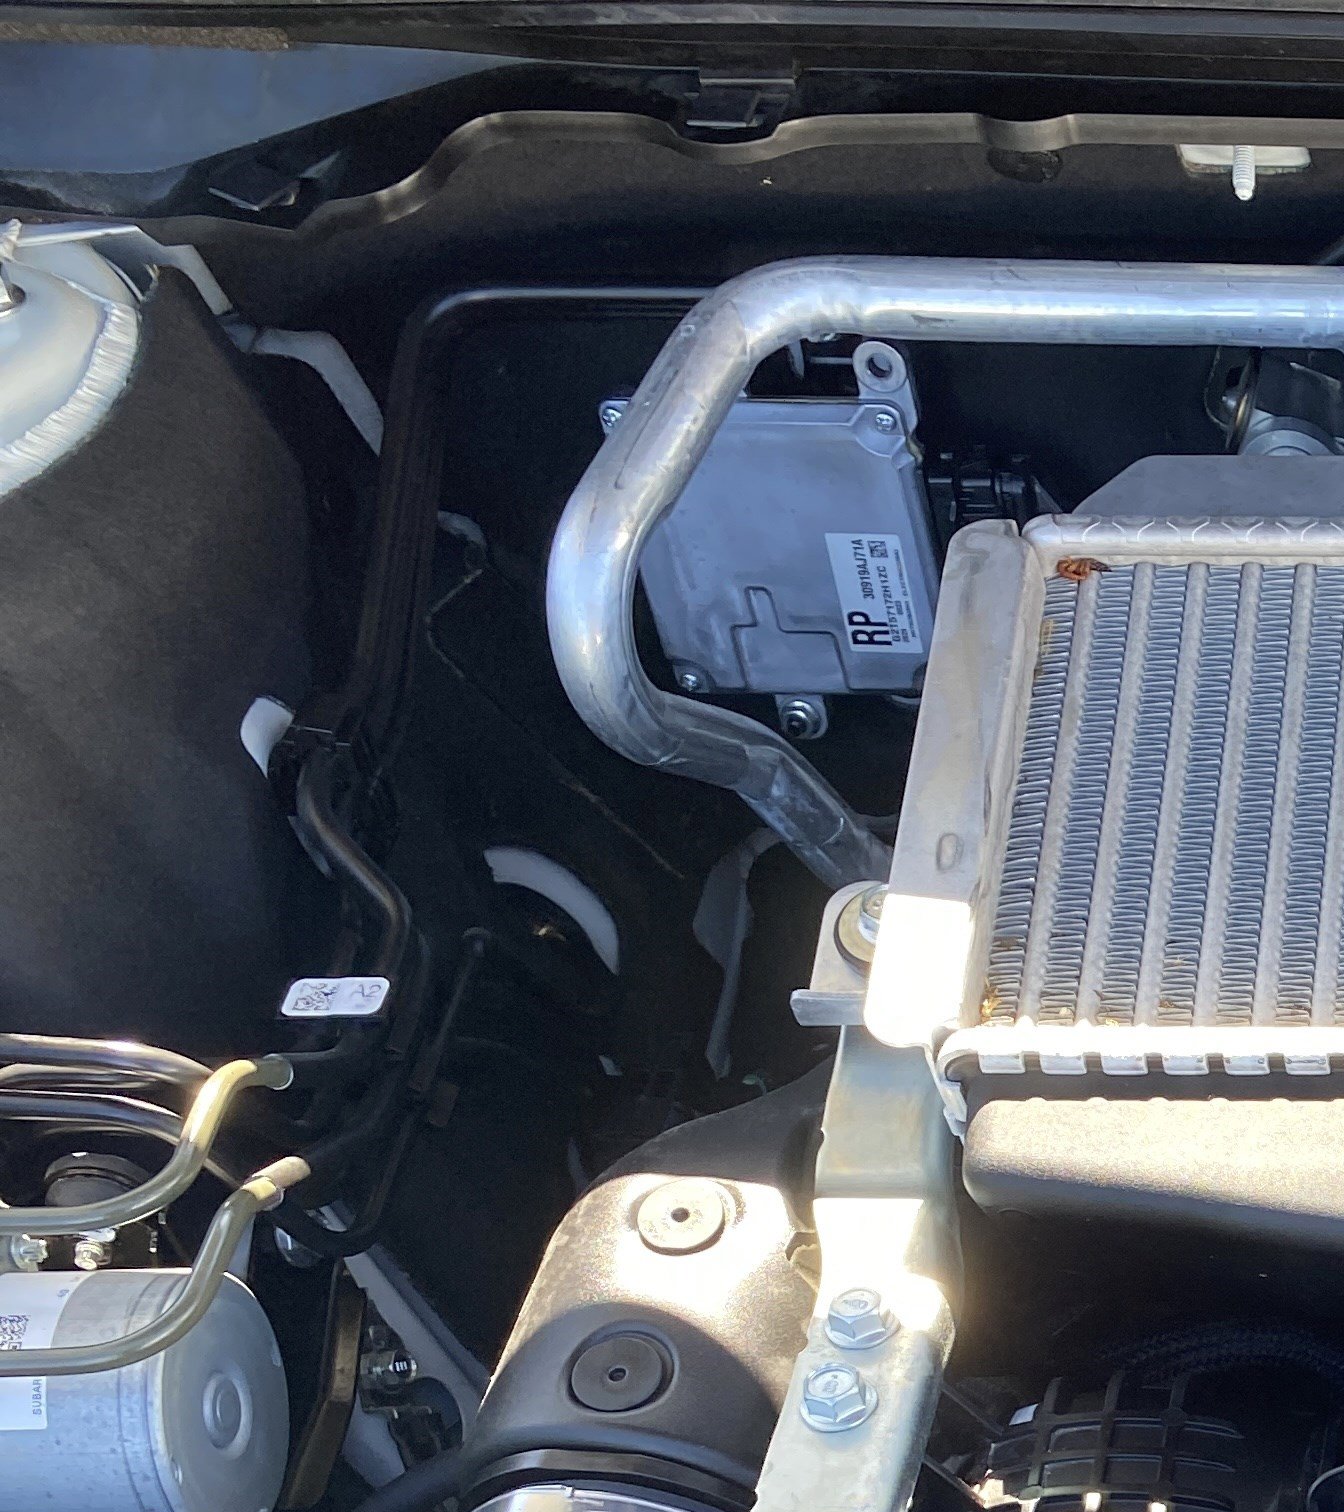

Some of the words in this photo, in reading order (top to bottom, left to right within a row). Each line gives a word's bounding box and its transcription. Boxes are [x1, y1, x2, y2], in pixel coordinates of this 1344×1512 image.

[851, 539, 875, 600] 30919AJ71A
[847, 610, 893, 646] RP
[32, 1379, 43, 1416] SUBAR
